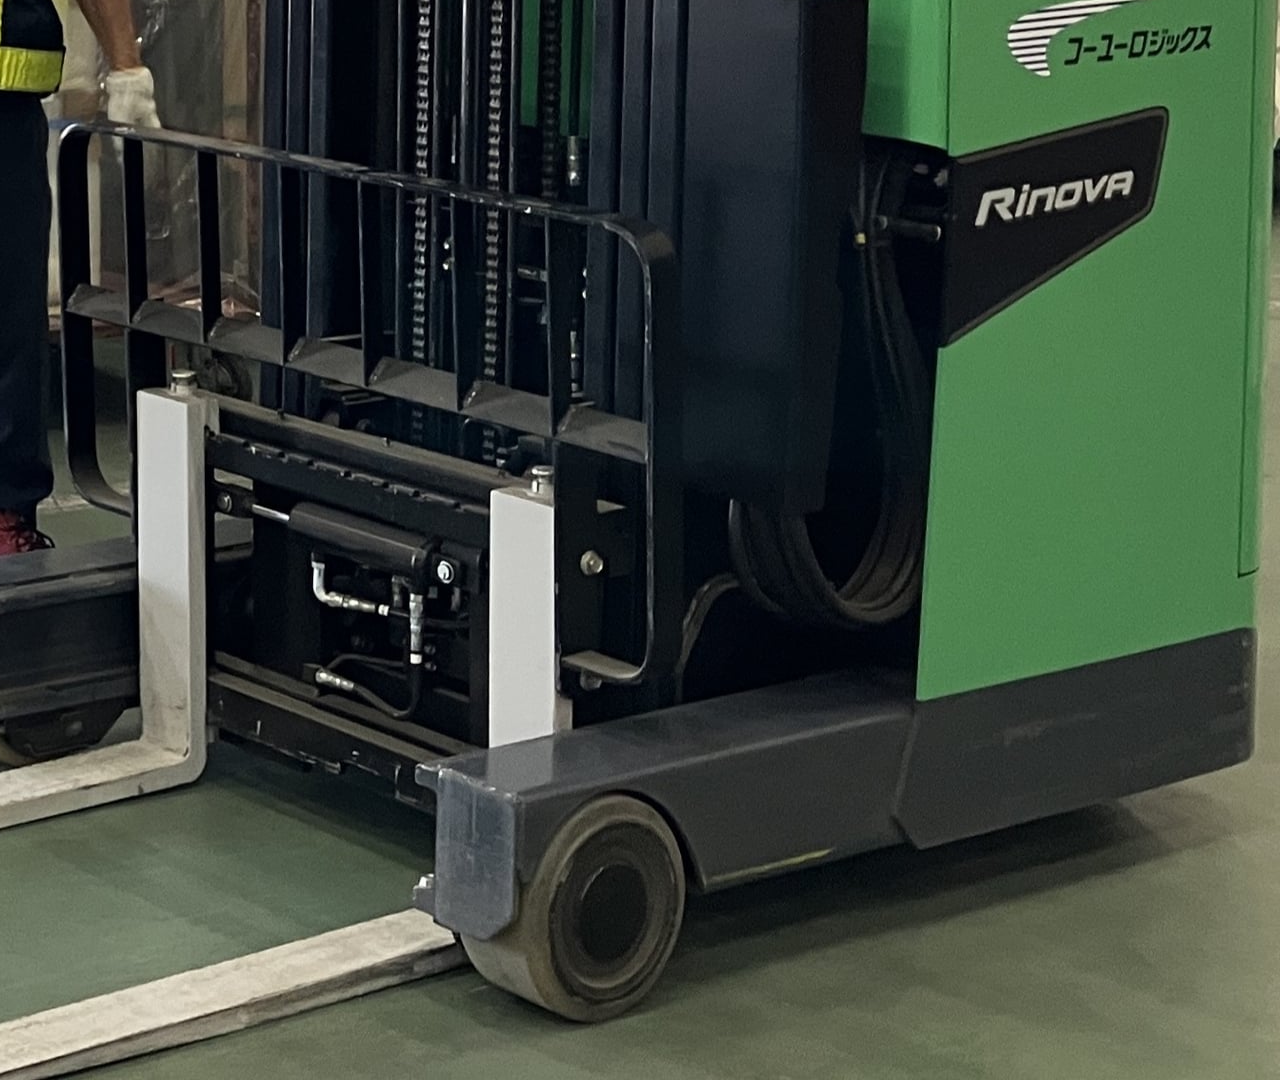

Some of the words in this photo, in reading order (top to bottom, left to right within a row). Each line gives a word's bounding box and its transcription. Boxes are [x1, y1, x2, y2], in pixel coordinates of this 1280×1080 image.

[1063, 25, 1213, 66] コーユーロジックス
